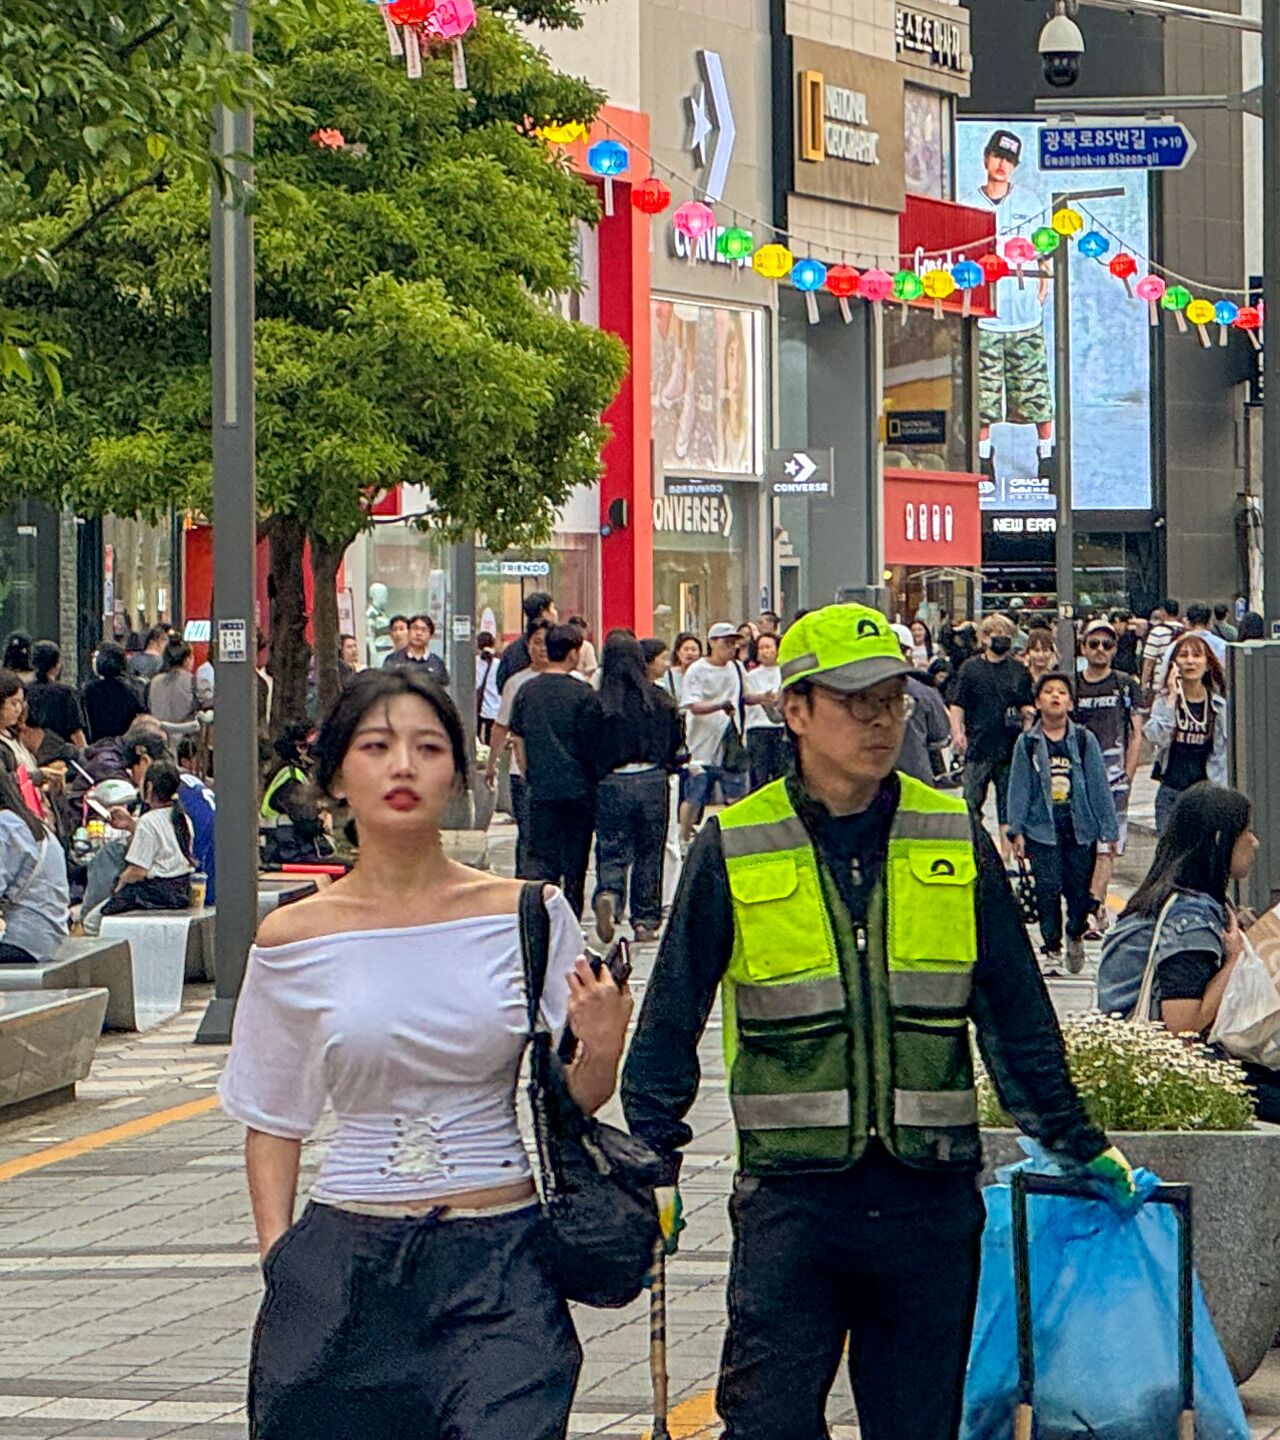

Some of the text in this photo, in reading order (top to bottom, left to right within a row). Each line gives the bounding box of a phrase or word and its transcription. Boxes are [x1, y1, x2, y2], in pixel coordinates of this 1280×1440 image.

[1043, 128, 1147, 152] 광복로85번길
[773, 482, 829, 494] CONVERSE
[653, 497, 720, 533] ONVERSE
[993, 517, 1057, 532] NEW ERA
[501, 562, 548, 574] FRIENDS
